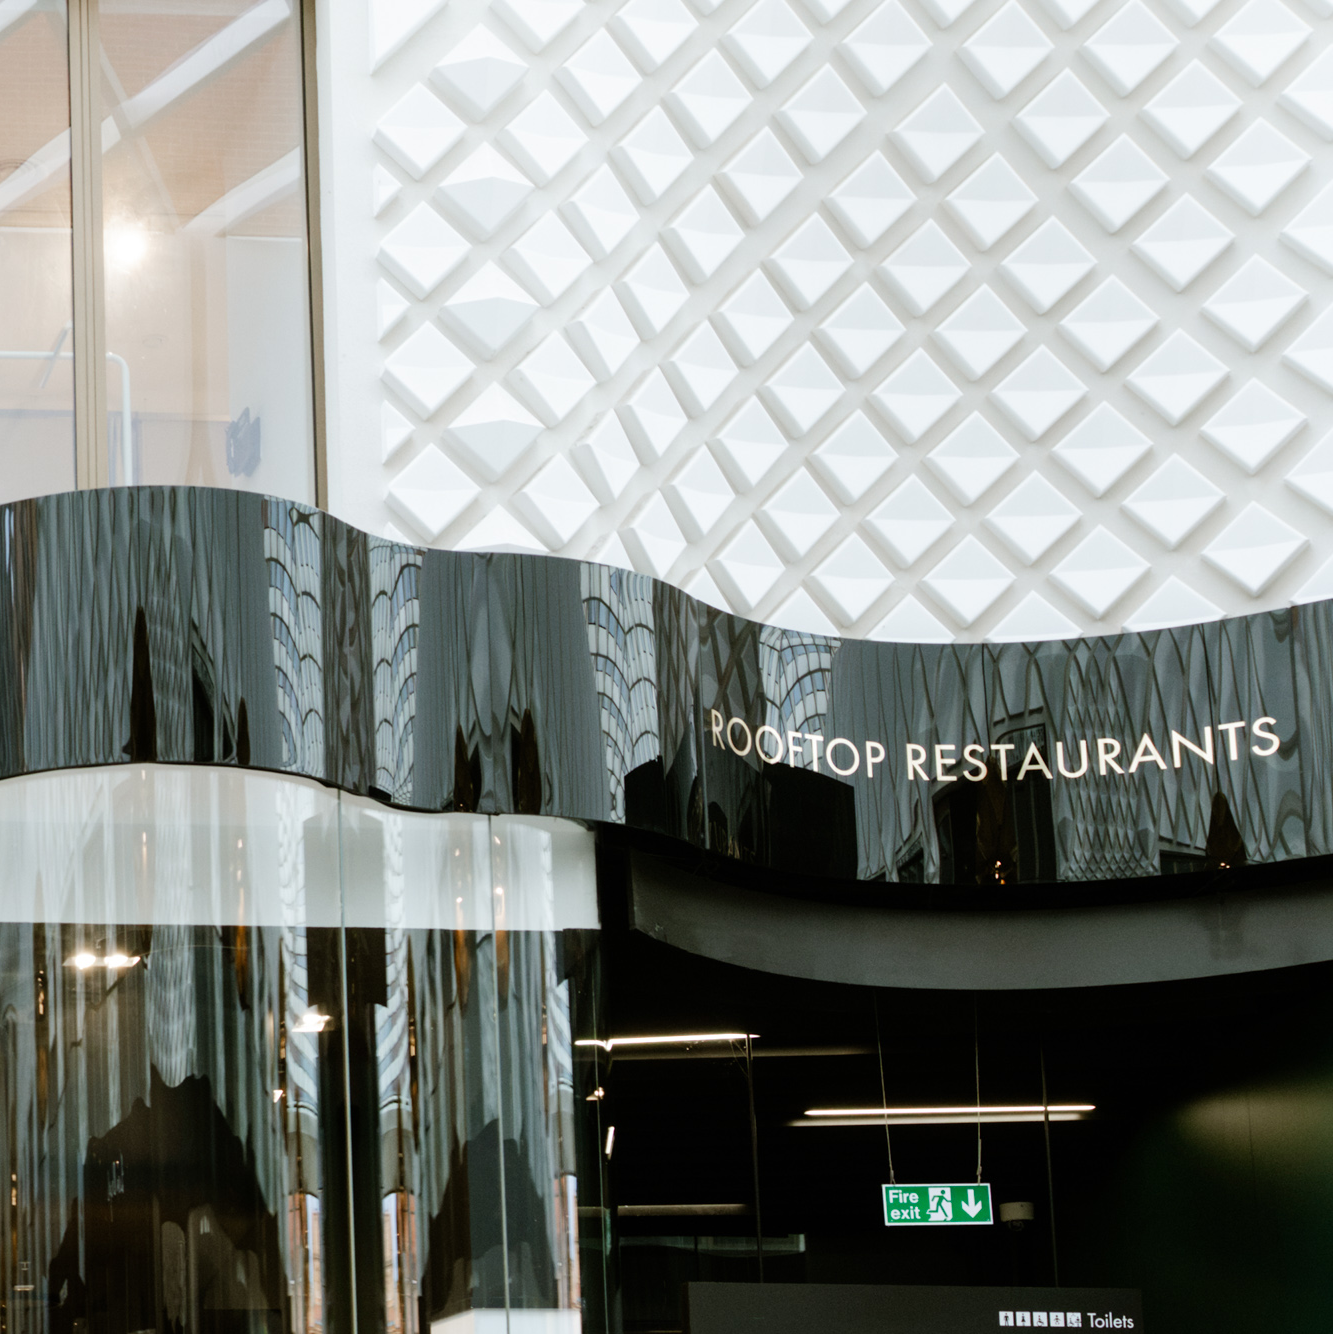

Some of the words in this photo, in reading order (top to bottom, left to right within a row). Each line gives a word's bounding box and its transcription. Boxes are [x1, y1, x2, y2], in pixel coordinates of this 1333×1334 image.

[710, 707, 886, 780] ROOFTOP
[906, 715, 1281, 782] RESTAURANTS
[888, 1189, 919, 1204] Fire
[890, 1204, 922, 1221] exit
[1086, 1312, 1135, 1330] Toilets
